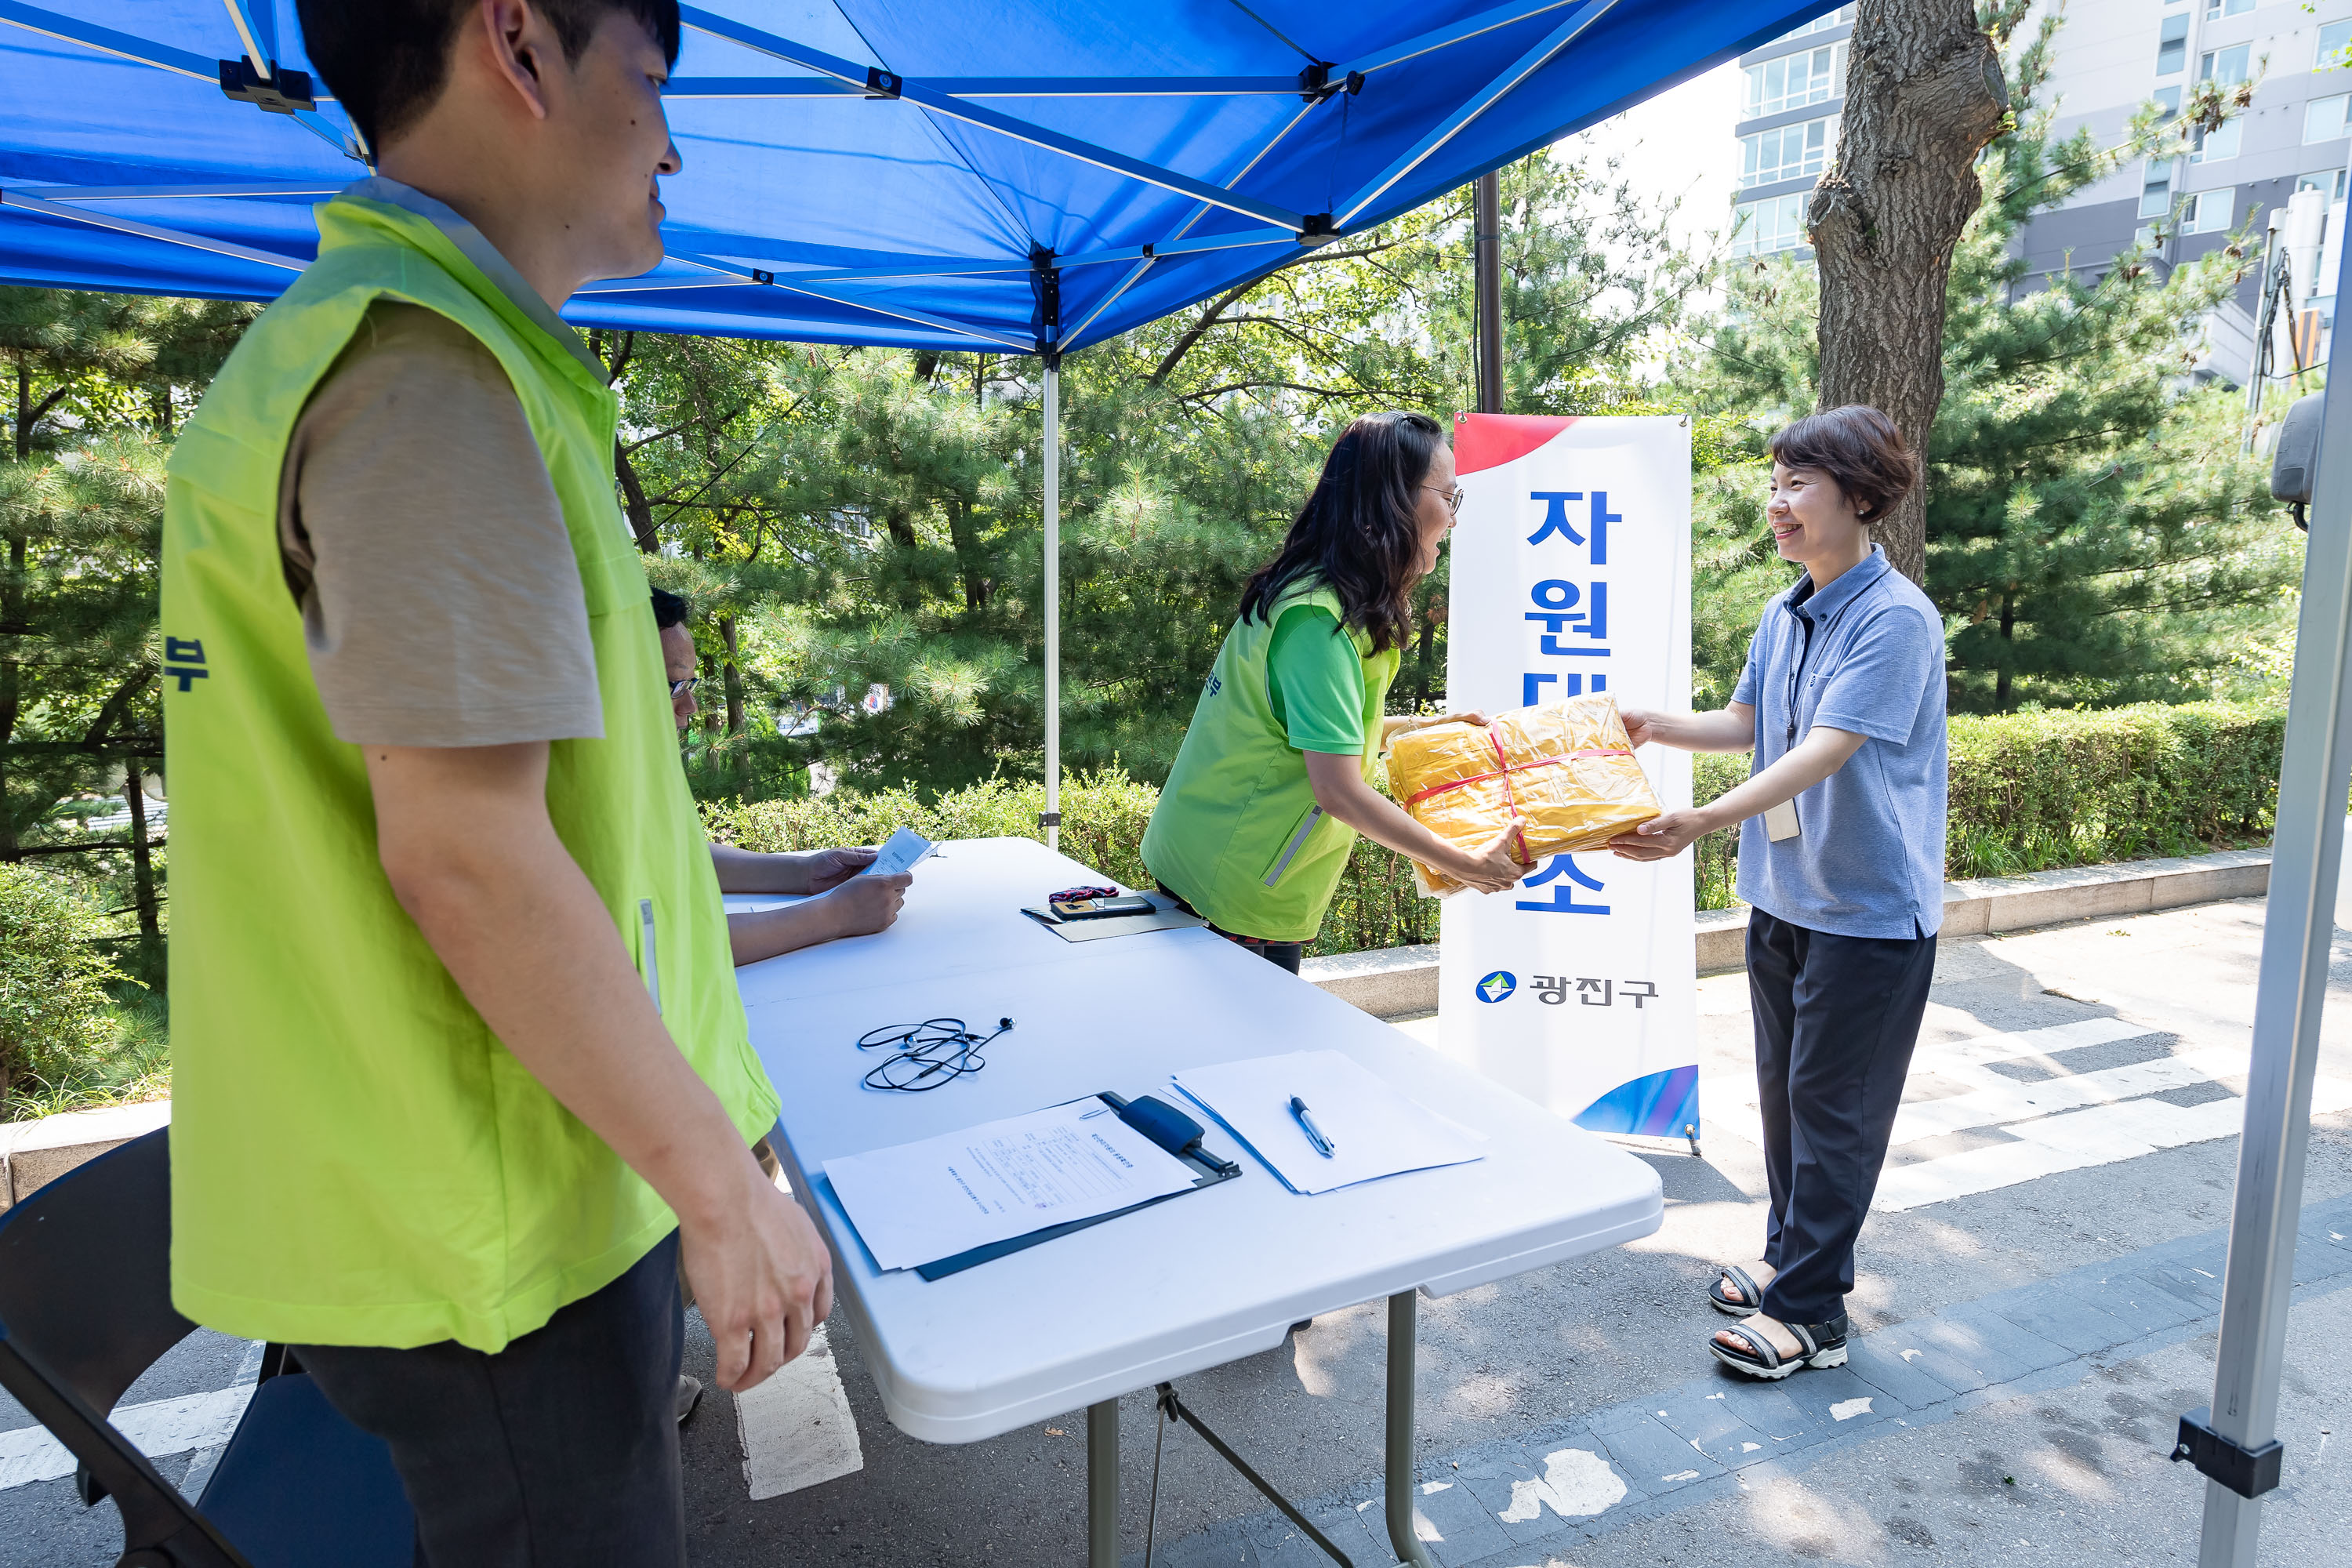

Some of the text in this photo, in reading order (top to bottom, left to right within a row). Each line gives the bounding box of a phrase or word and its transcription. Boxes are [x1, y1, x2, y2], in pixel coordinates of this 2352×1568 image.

[163, 636, 209, 692] 부
[1514, 491, 1622, 915] 자원소
[1530, 975, 1659, 1009] 광진구
